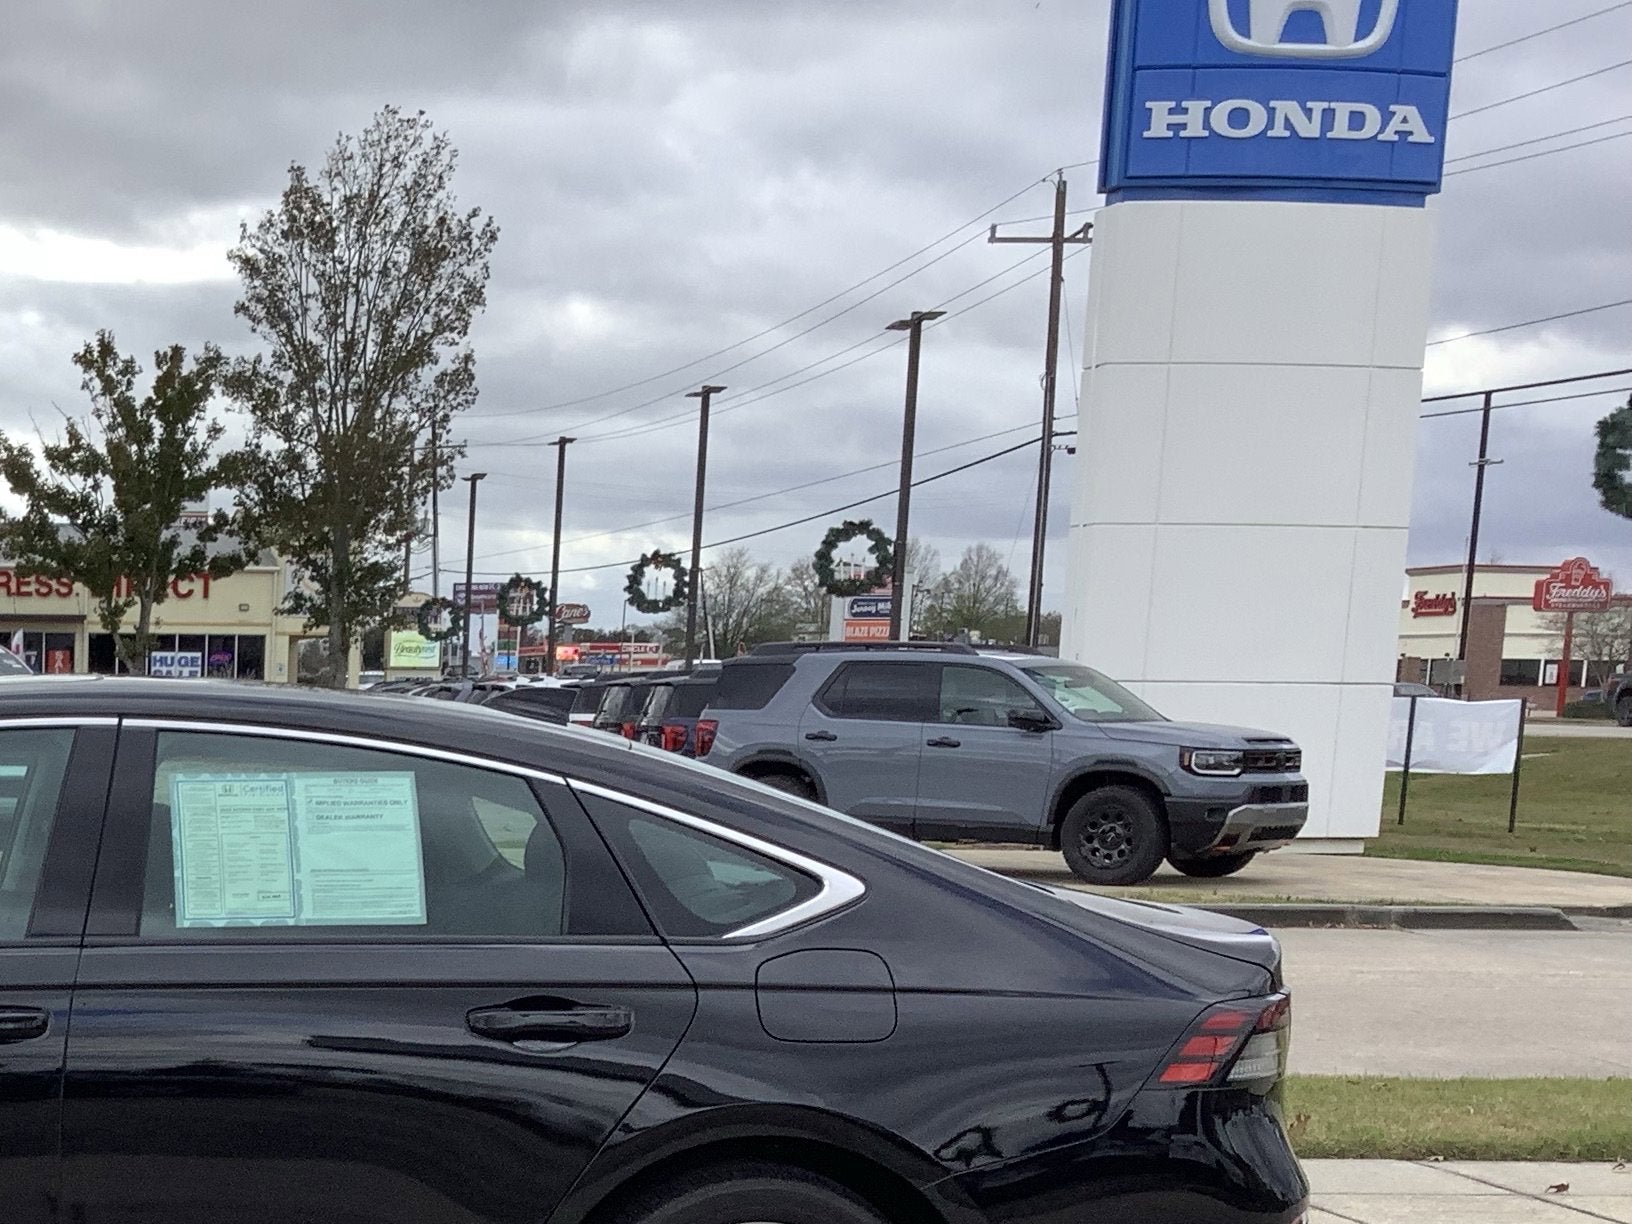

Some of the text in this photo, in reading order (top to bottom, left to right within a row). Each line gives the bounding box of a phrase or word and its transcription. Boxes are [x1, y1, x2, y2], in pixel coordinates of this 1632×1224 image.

[1142, 98, 1436, 144] HONDA
[1546, 582, 1608, 603] Freddy's
[555, 603, 588, 622] Cane's
[1411, 590, 1456, 618] Freddy's
[845, 626, 890, 637] BLAZE PIZZ
[152, 655, 201, 667] HUGE
[243, 784, 284, 793] Certified
